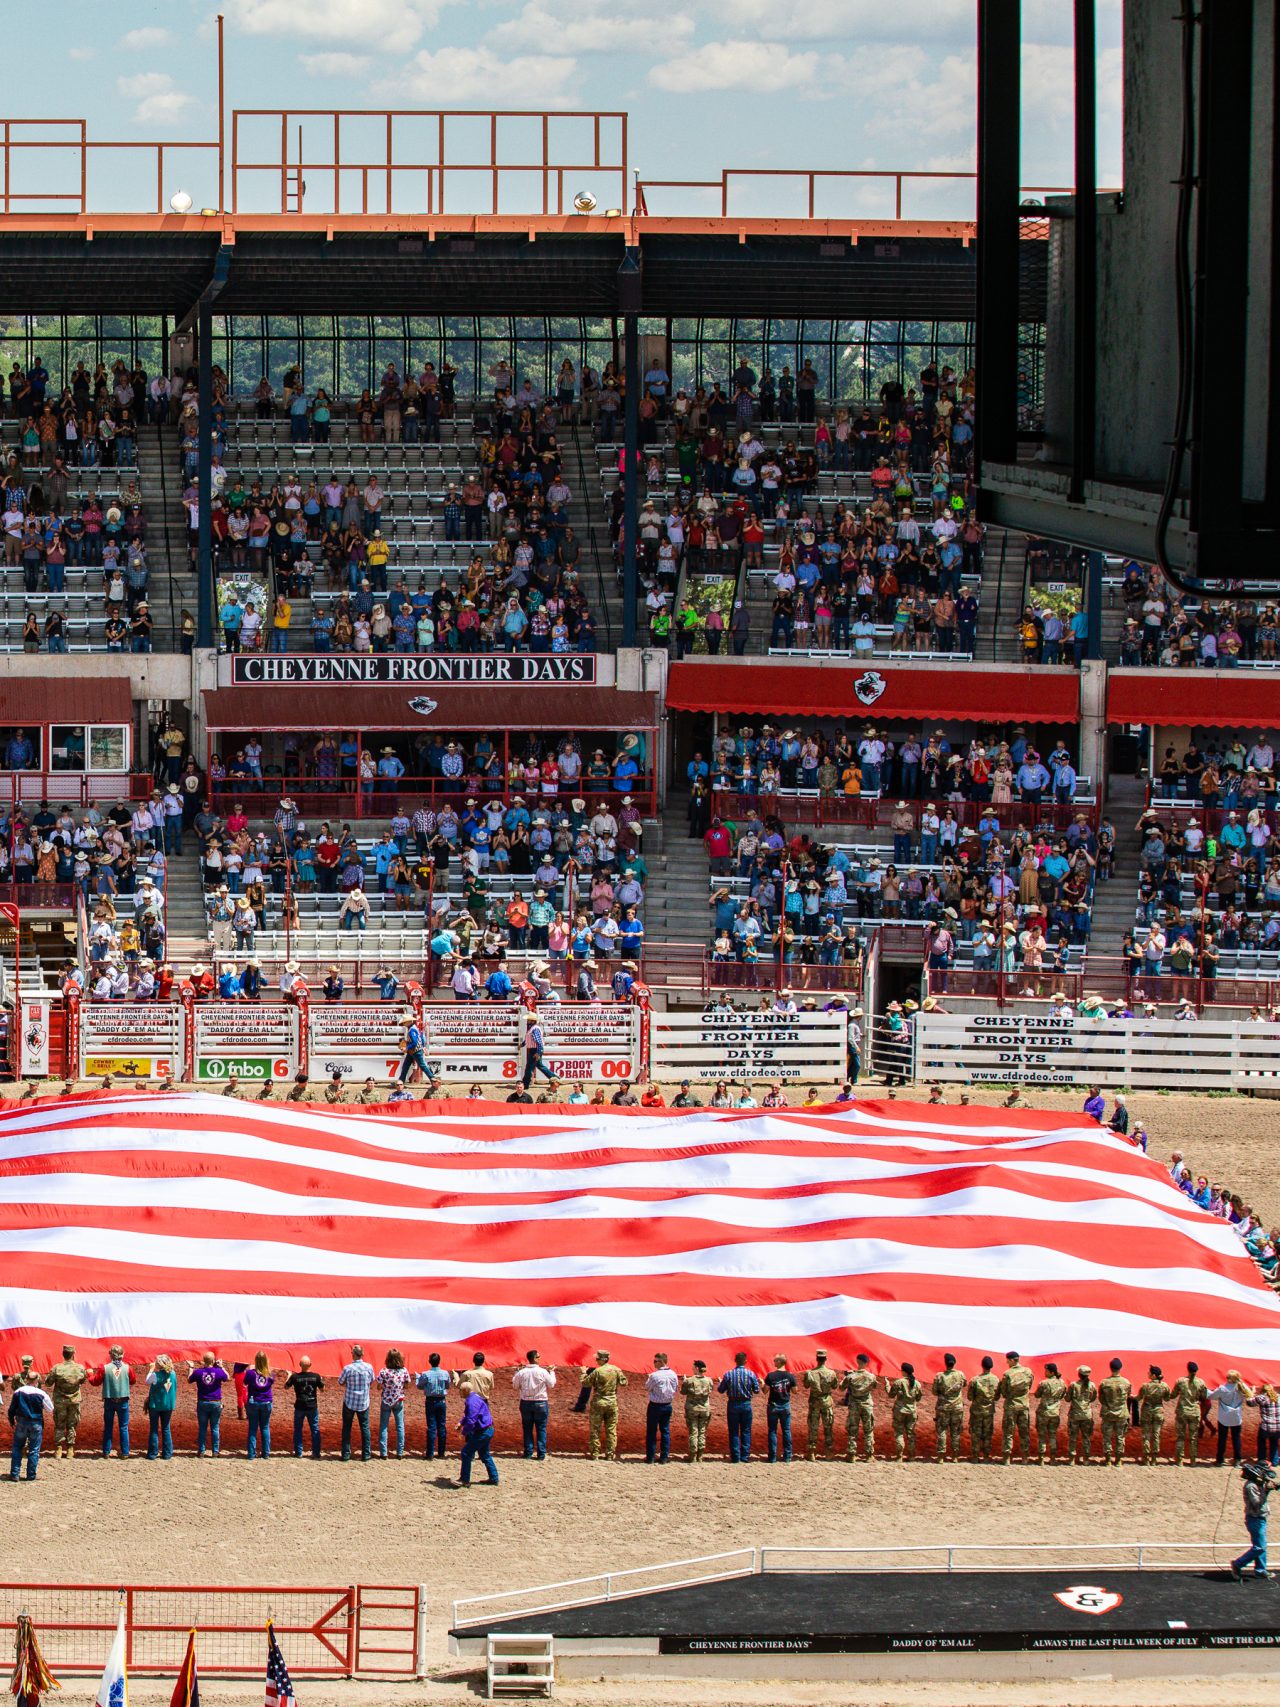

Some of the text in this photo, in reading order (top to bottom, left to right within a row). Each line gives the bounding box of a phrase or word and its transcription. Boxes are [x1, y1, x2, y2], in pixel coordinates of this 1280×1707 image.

[244, 658, 583, 681] CHEYENNE FRONTIER DAYS
[702, 1015, 800, 1023] CHEYENNE
[974, 1017, 1073, 1027] CHEYENNE
[701, 1033, 799, 1041] FRONTIER
[974, 1036, 1073, 1046] FRONTIER
[999, 1054, 1046, 1062] DAYS
[157, 1060, 169, 1077] 5
[227, 1062, 264, 1076] fnbo
[274, 1059, 288, 1077] 6
[325, 1062, 353, 1073] Coors
[386, 1060, 400, 1077] 7
[502, 1060, 517, 1078] 8
[566, 1061, 592, 1069] BOOT
[601, 1060, 631, 1078] 00
[566, 1070, 592, 1078] BARN
[700, 1069, 800, 1077] www.cfdrodeo.com
[971, 1072, 1073, 1082] www.cfdrodeo.com
[689, 1641, 737, 1649] CHEYENNE
[739, 1641, 784, 1649] FRONTIER
[938, 1639, 956, 1647] 'EM
